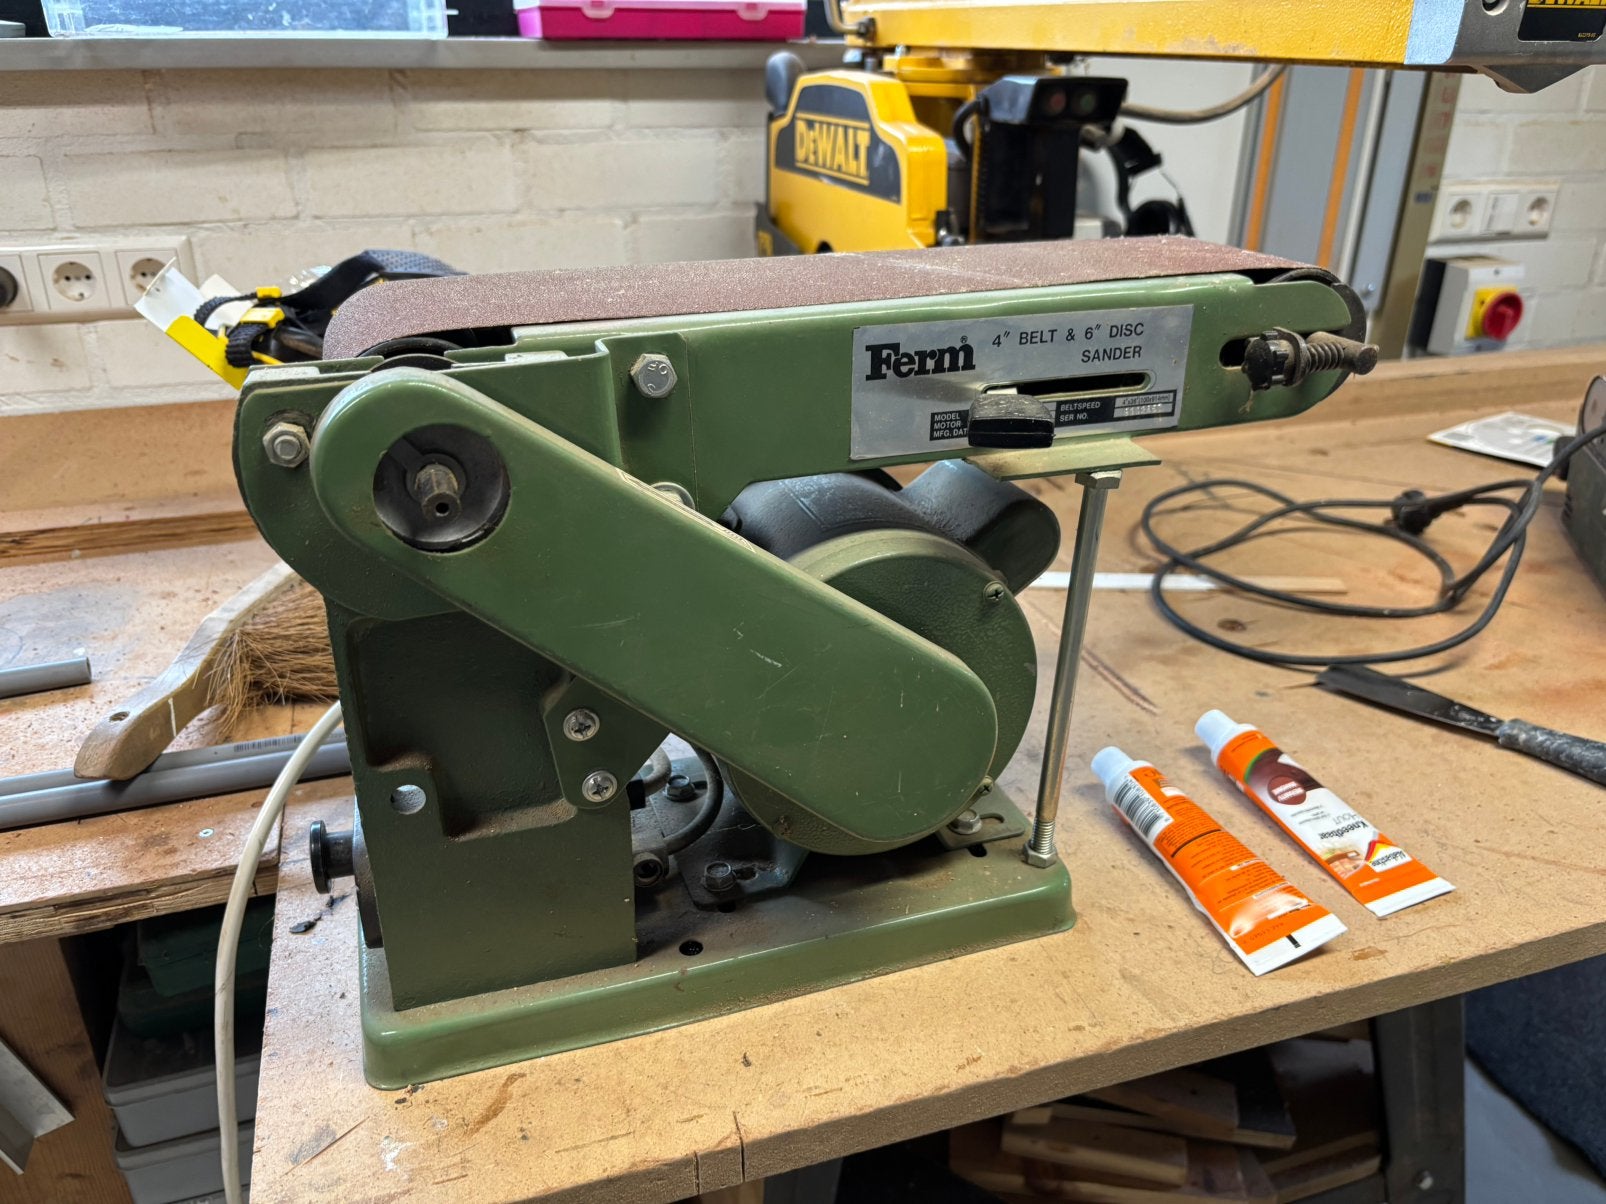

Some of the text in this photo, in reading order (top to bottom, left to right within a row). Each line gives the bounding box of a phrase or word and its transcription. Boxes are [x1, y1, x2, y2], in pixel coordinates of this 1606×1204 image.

[1019, 329, 1057, 345] BELT
[1066, 328, 1075, 341] &
[1109, 322, 1144, 338] DISC
[1081, 345, 1142, 363] SANDER
[1060, 402, 1100, 411] BELTSPEED
[934, 413, 960, 421] MODEL
[933, 420, 961, 429] MOTOR
[953, 427, 968, 436] DAT
[1318, 820, 1369, 840] Kneedbaar
